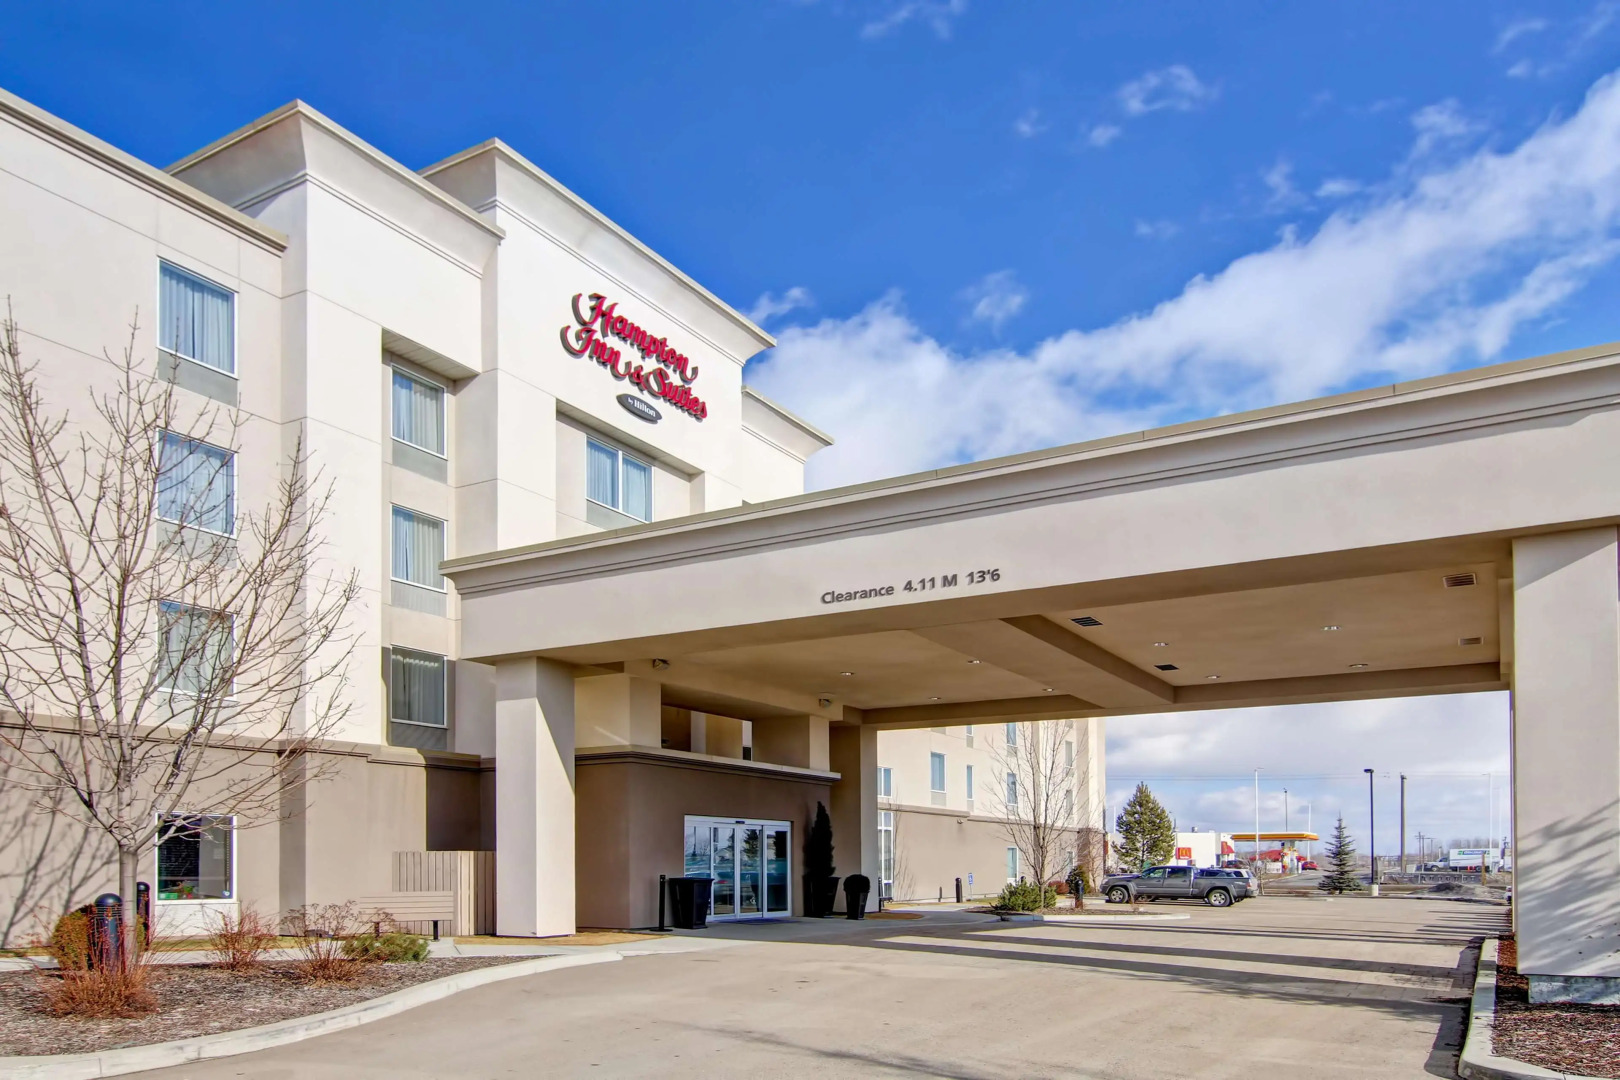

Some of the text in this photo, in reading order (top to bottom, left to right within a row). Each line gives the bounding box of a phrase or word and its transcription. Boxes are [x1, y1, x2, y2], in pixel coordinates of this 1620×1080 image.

[572, 293, 699, 384] Hampton
[560, 325, 632, 379] Inn
[644, 367, 707, 421] Suites
[634, 399, 656, 417] Hilton
[820, 568, 1000, 604] Clearance 4.11 M 13'6
